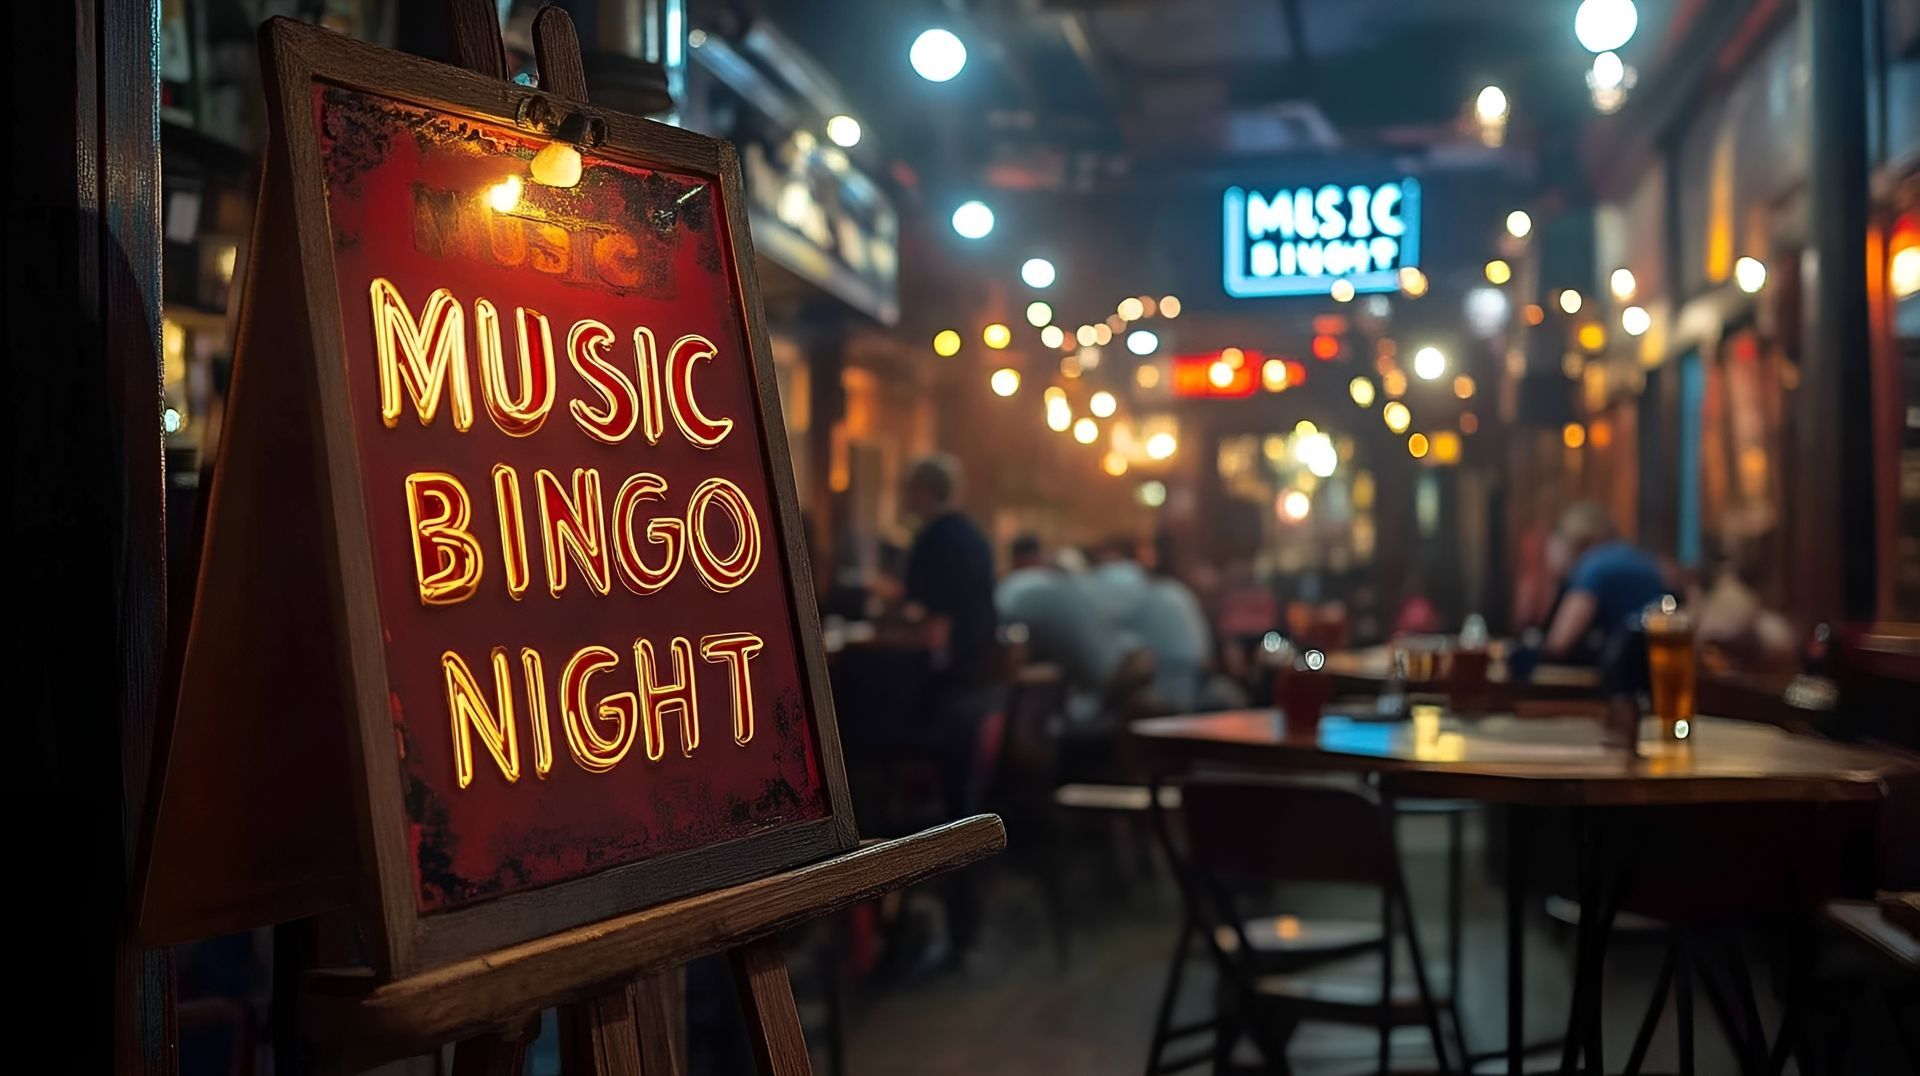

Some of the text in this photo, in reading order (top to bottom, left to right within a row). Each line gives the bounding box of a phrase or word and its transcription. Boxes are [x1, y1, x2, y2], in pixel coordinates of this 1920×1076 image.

[369, 277, 734, 449] MUSIC
[405, 463, 762, 605] BINGO
[441, 632, 764, 789] NIGHT
